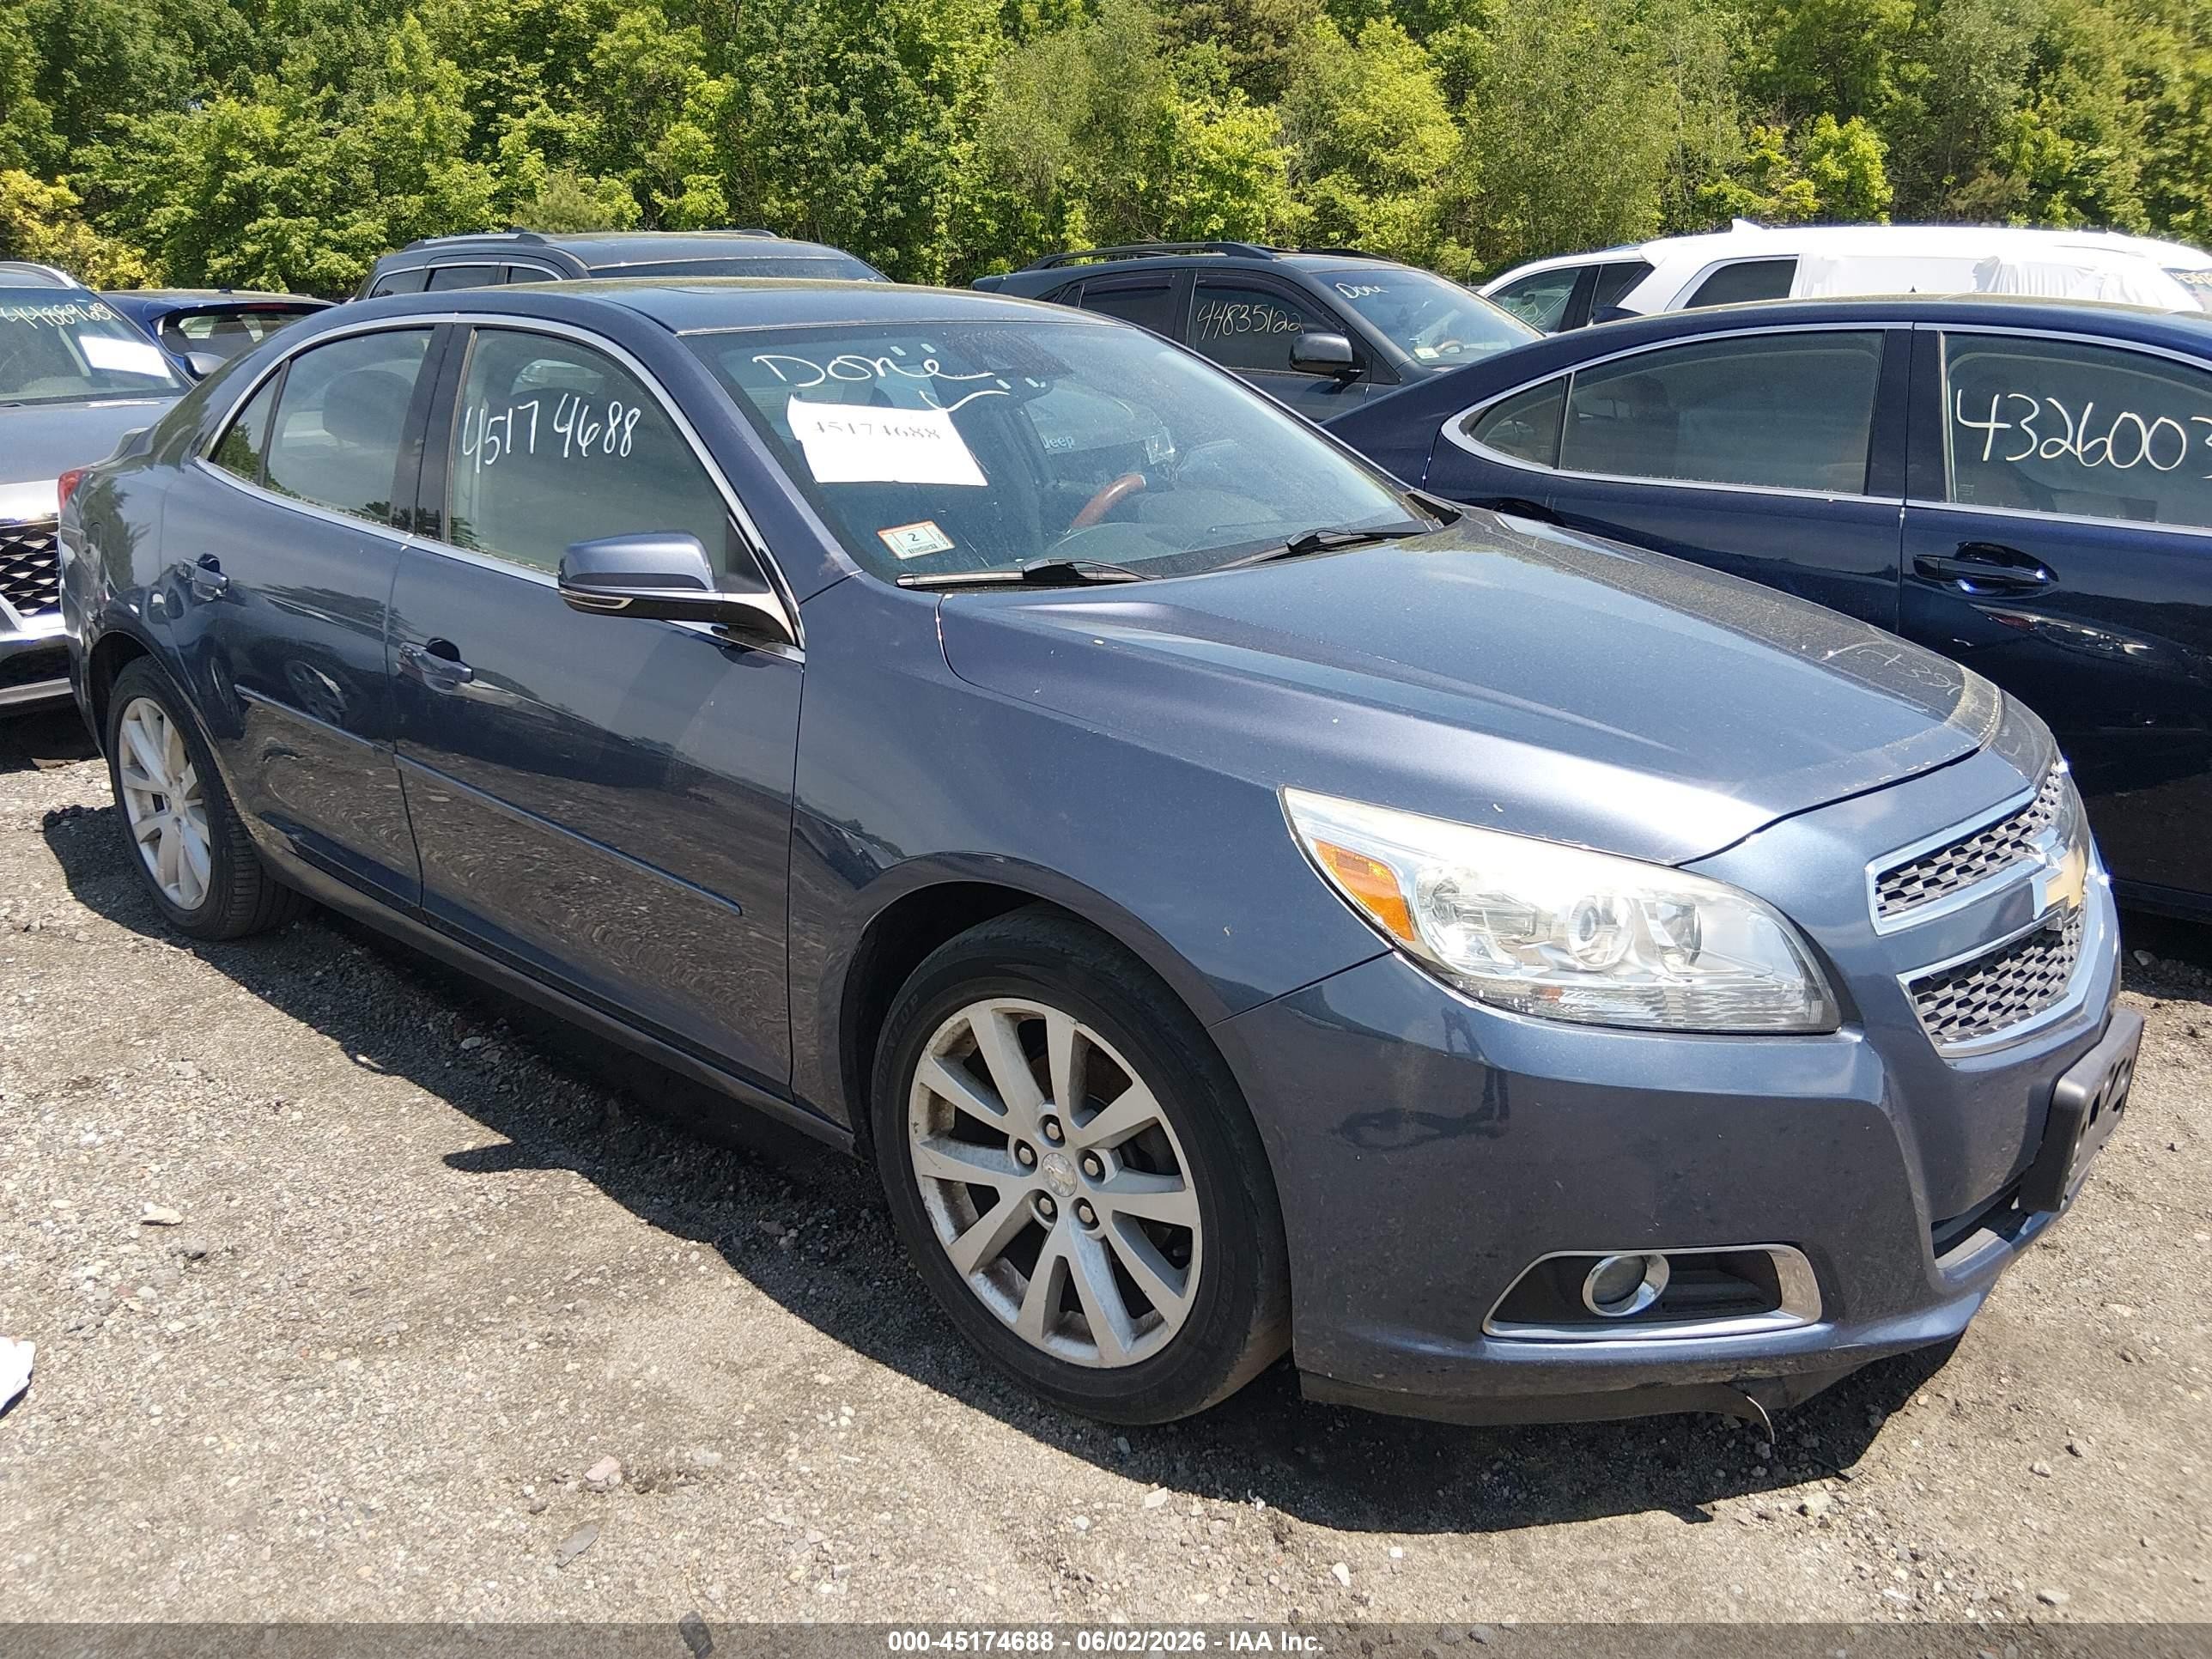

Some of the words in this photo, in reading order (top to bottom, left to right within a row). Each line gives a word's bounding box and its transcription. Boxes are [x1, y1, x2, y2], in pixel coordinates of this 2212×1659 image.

[1197, 301, 1304, 340] 44835122
[752, 355, 995, 387] Done
[1039, 434, 1074, 449] Jeep
[908, 532, 921, 542] 2
